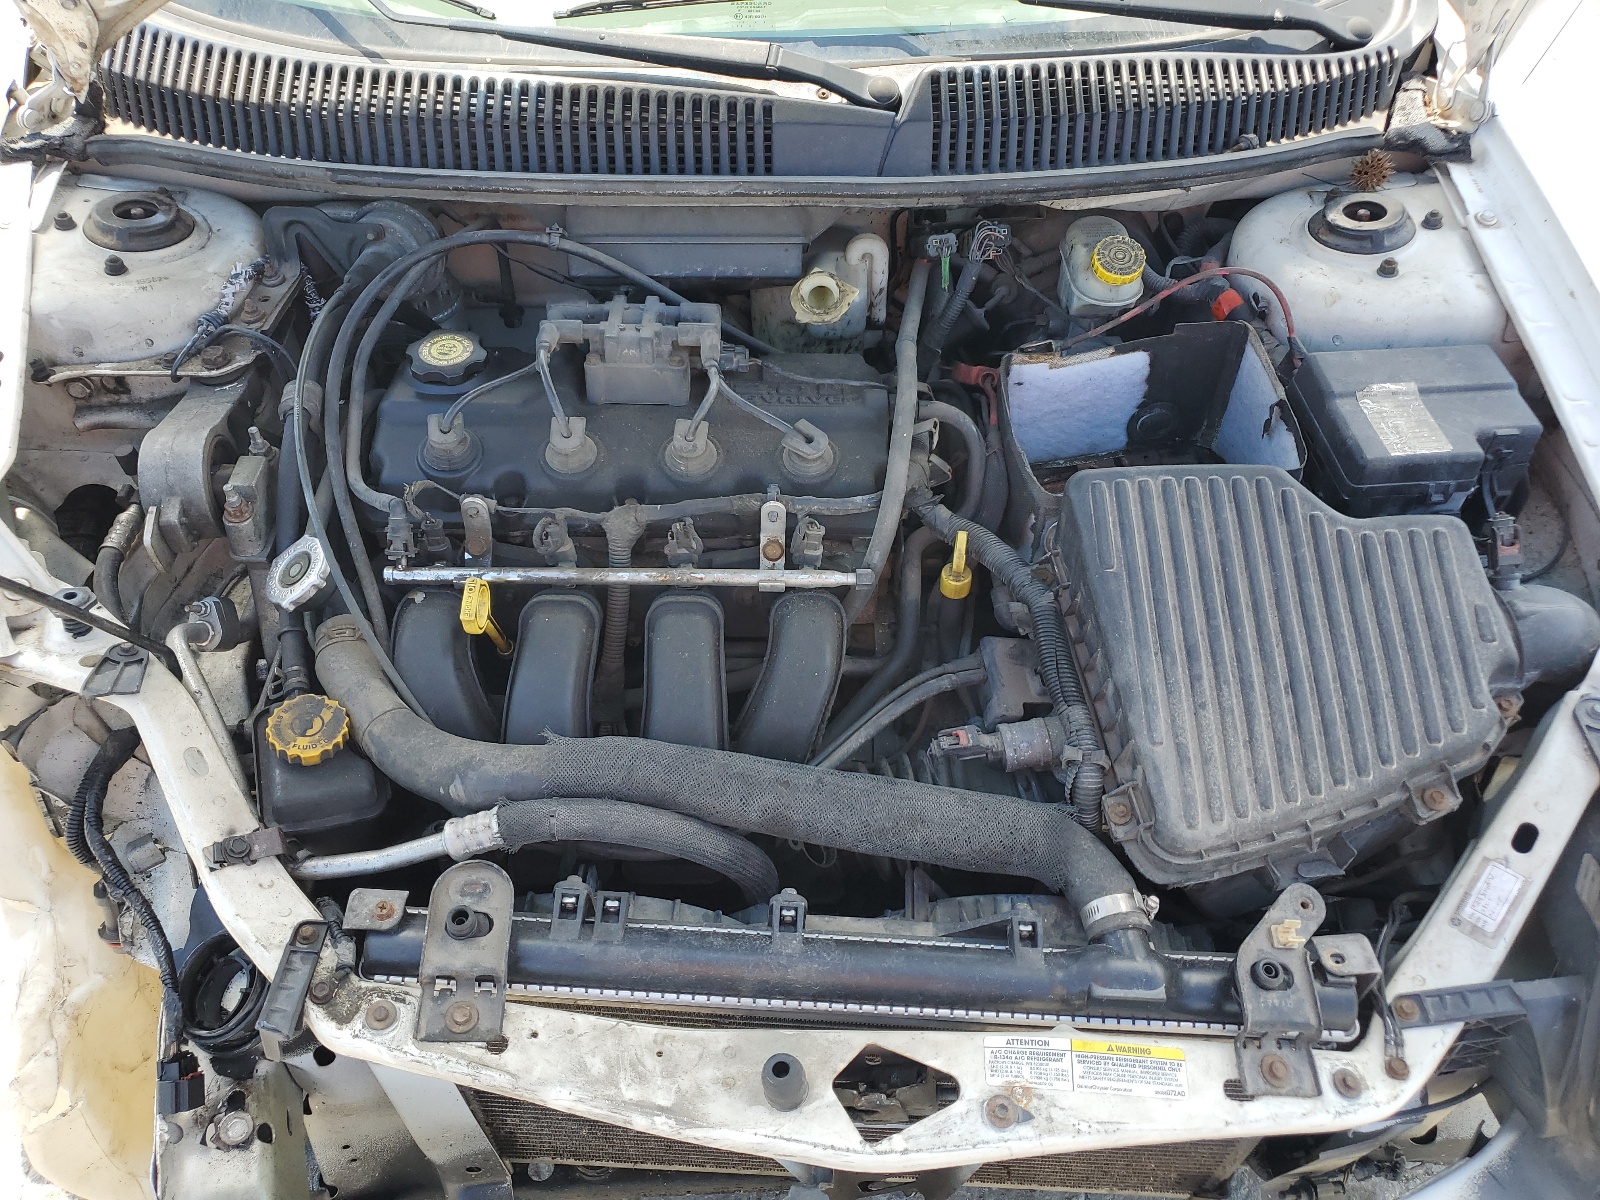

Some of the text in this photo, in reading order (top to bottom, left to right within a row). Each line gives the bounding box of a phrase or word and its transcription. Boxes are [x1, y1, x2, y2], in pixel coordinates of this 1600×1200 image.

[292, 742, 318, 750] FLUID
[1006, 1038, 1050, 1047] ATTENTION
[1115, 1044, 1152, 1055] WARNING
[1075, 1053, 1114, 1061] HIGH-PRESSURE
